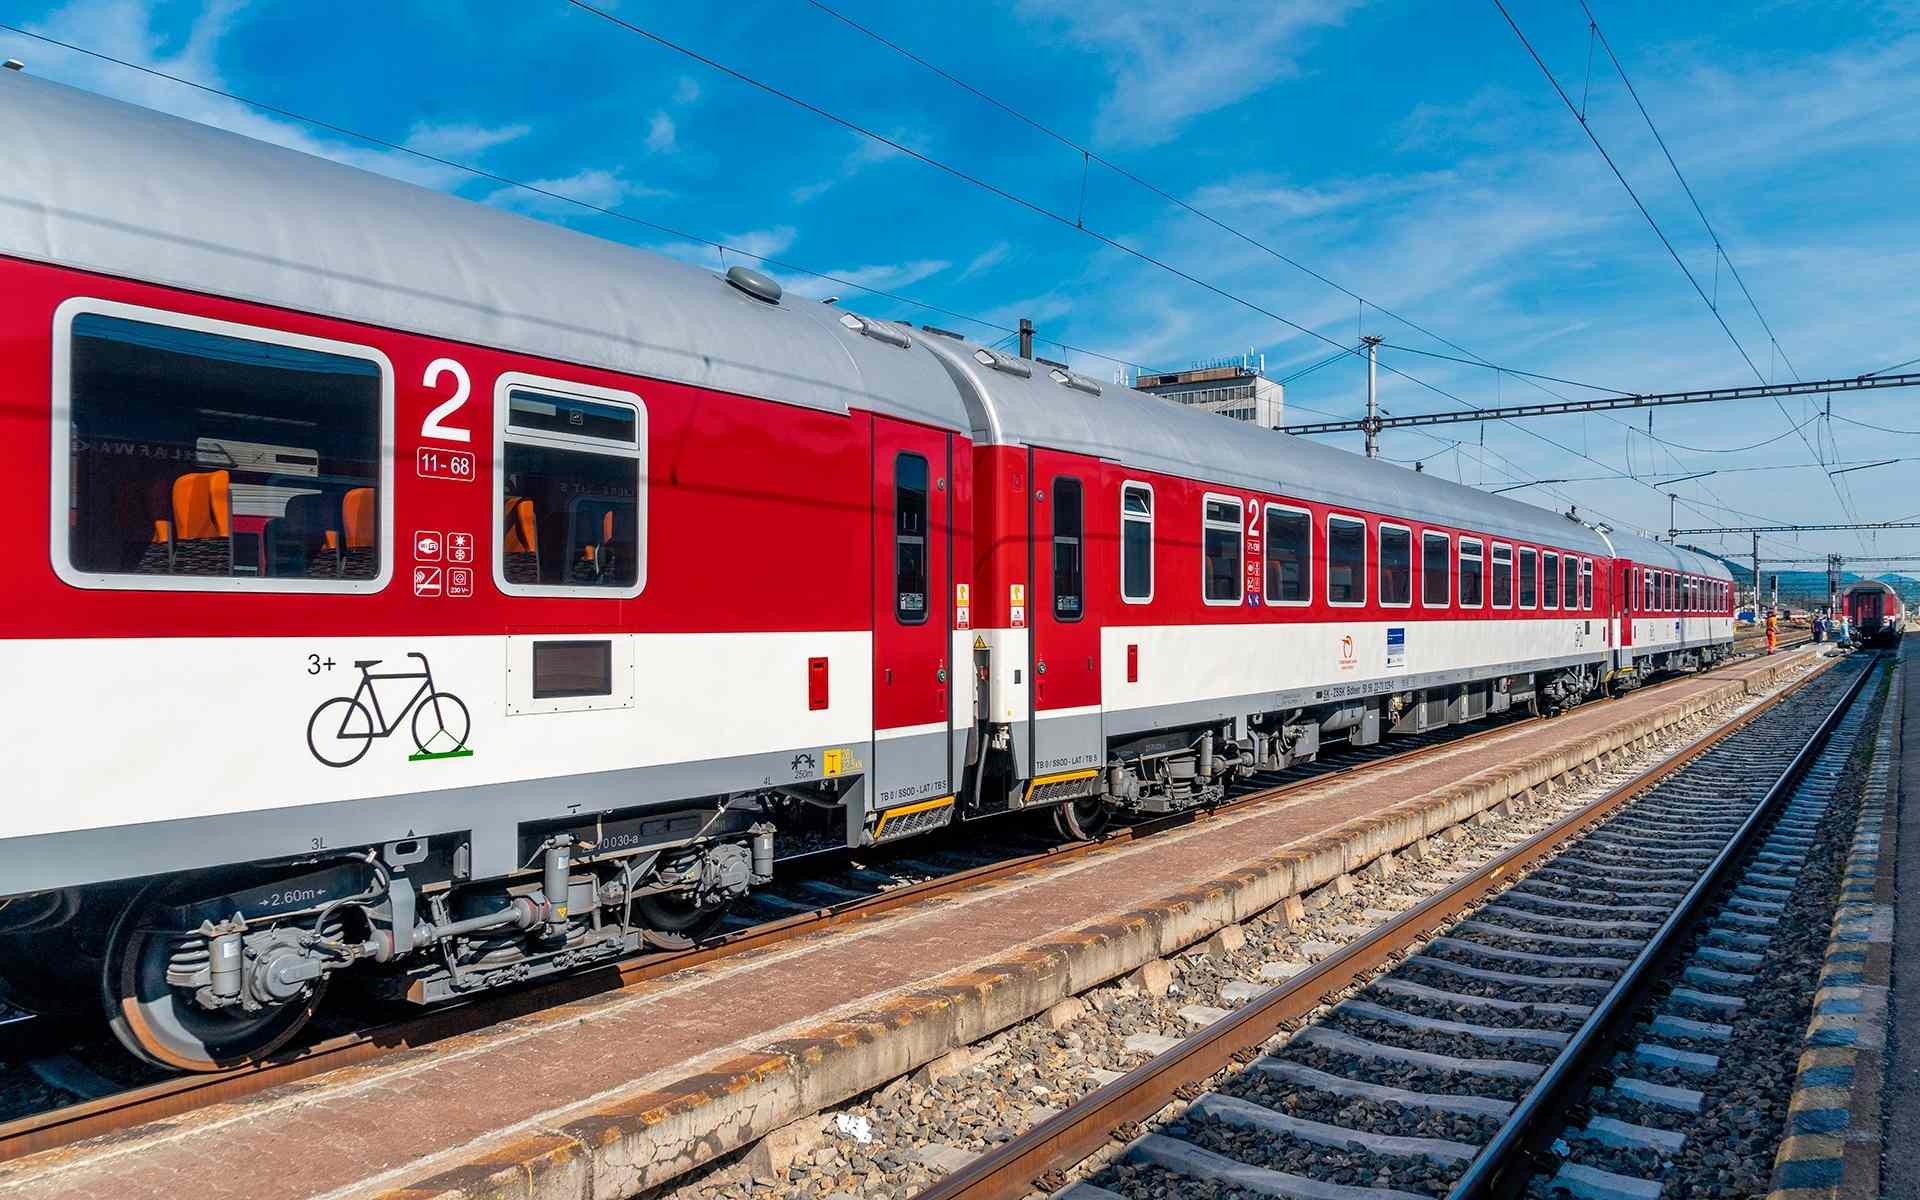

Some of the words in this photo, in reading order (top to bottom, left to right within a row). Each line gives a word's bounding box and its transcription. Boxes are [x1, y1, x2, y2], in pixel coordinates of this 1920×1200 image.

[421, 357, 471, 442] 2
[1247, 498, 1260, 537] 2
[307, 653, 336, 675] 3+
[920, 784, 930, 793] LAT
[311, 837, 327, 850] 3L
[271, 889, 315, 907] 2.60m
